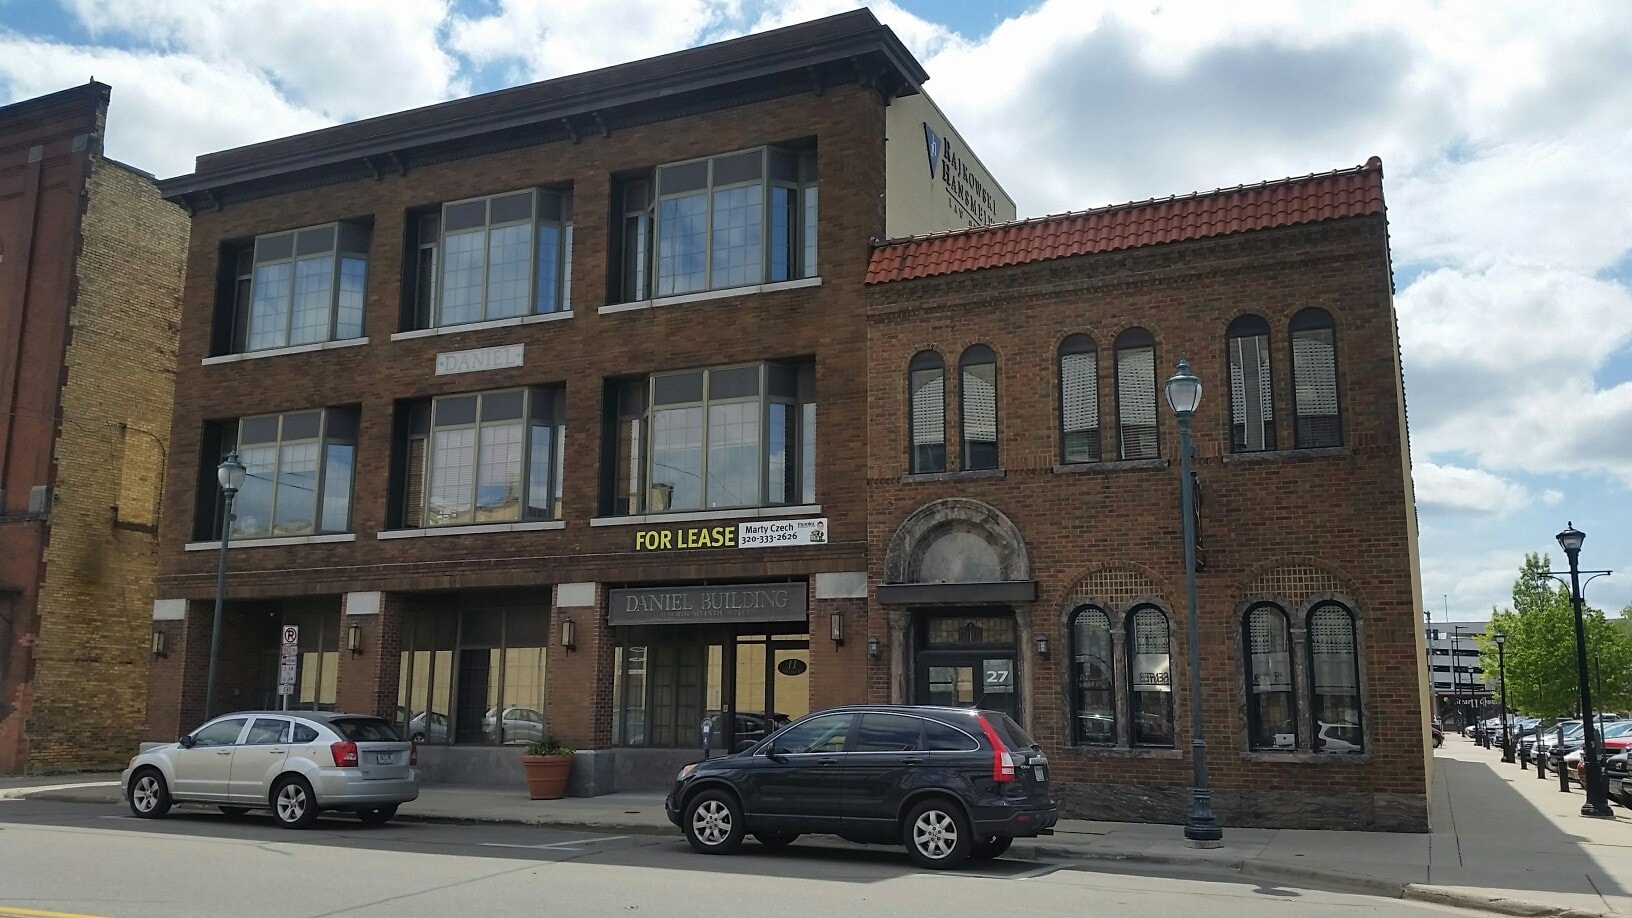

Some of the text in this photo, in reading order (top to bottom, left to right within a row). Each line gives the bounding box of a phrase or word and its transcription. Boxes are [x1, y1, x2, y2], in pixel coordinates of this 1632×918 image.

[444, 349, 516, 372] DANIEL
[741, 531, 798, 545] 320-333-2626
[745, 525, 769, 535] Marty
[770, 523, 794, 532] Czech
[635, 526, 736, 551] FOR LEASE
[626, 590, 789, 612] DANIEL BUILDING
[986, 671, 1009, 683] 27
